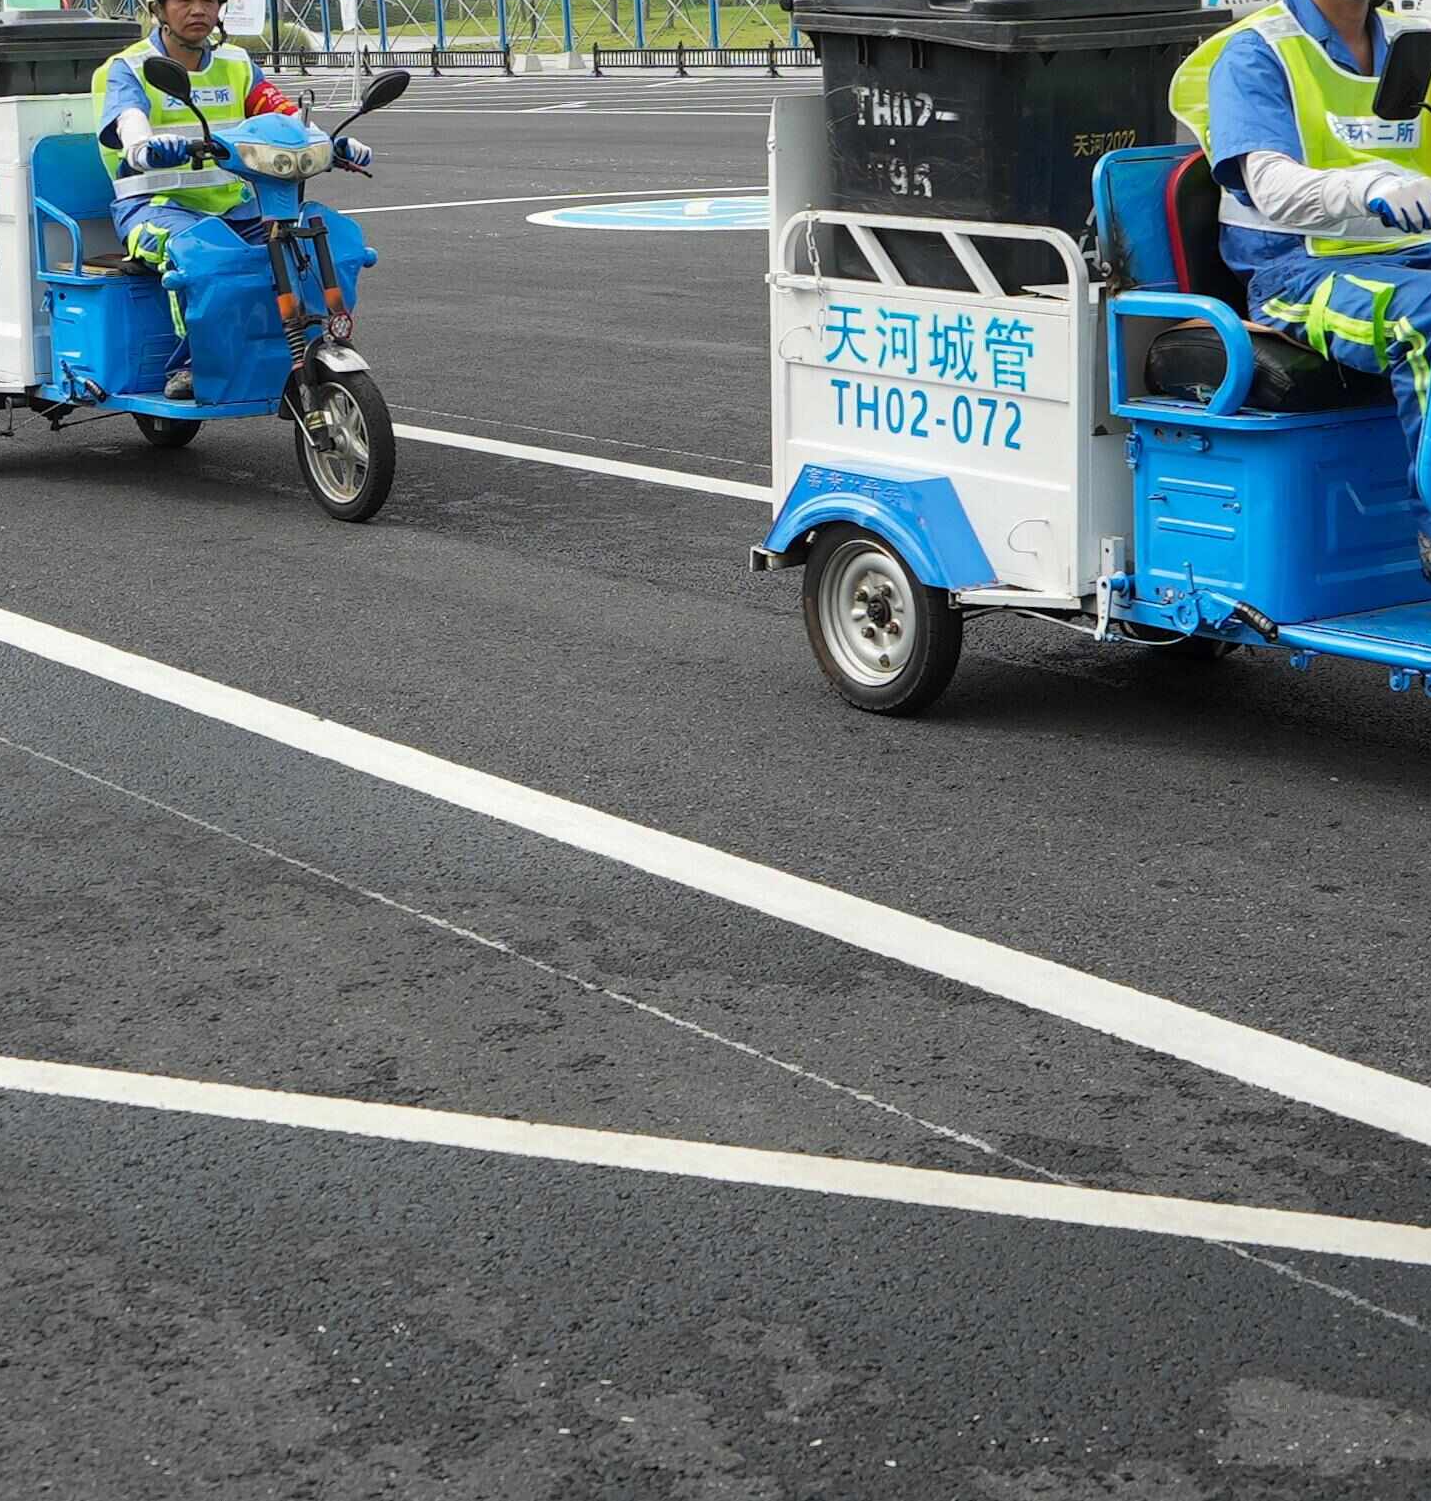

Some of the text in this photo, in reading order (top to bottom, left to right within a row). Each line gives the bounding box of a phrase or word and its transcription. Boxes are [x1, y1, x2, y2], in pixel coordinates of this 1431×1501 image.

[825, 304, 1035, 393] 天河城管
[830, 378, 1021, 451] TH02-072
